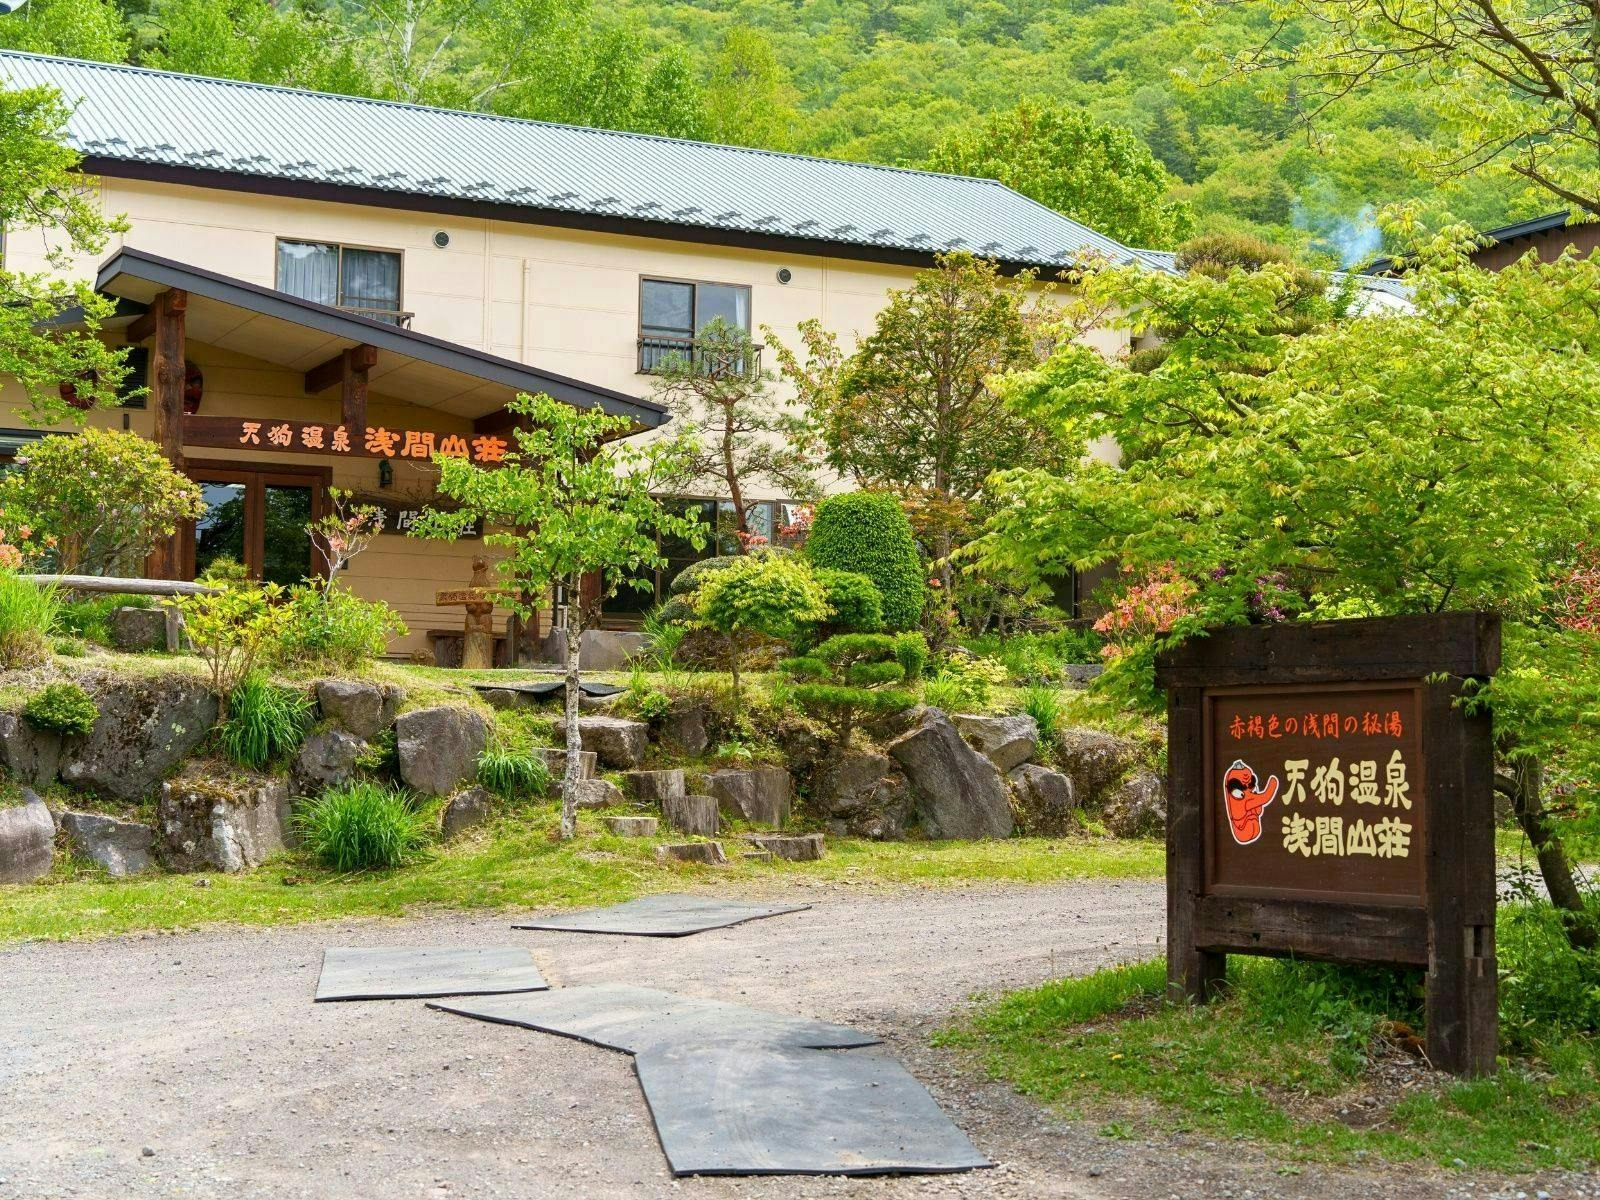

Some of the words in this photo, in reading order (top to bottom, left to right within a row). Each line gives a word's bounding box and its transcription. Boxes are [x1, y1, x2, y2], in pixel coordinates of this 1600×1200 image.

[240, 422, 352, 453] 天狗温泉
[365, 427, 508, 462] 浅間山荘
[1229, 710, 1404, 740] 赤褐色の浅間の秘湯
[1281, 749, 1413, 810] 天狗温泉
[1281, 812, 1413, 859] 浅間山荘
